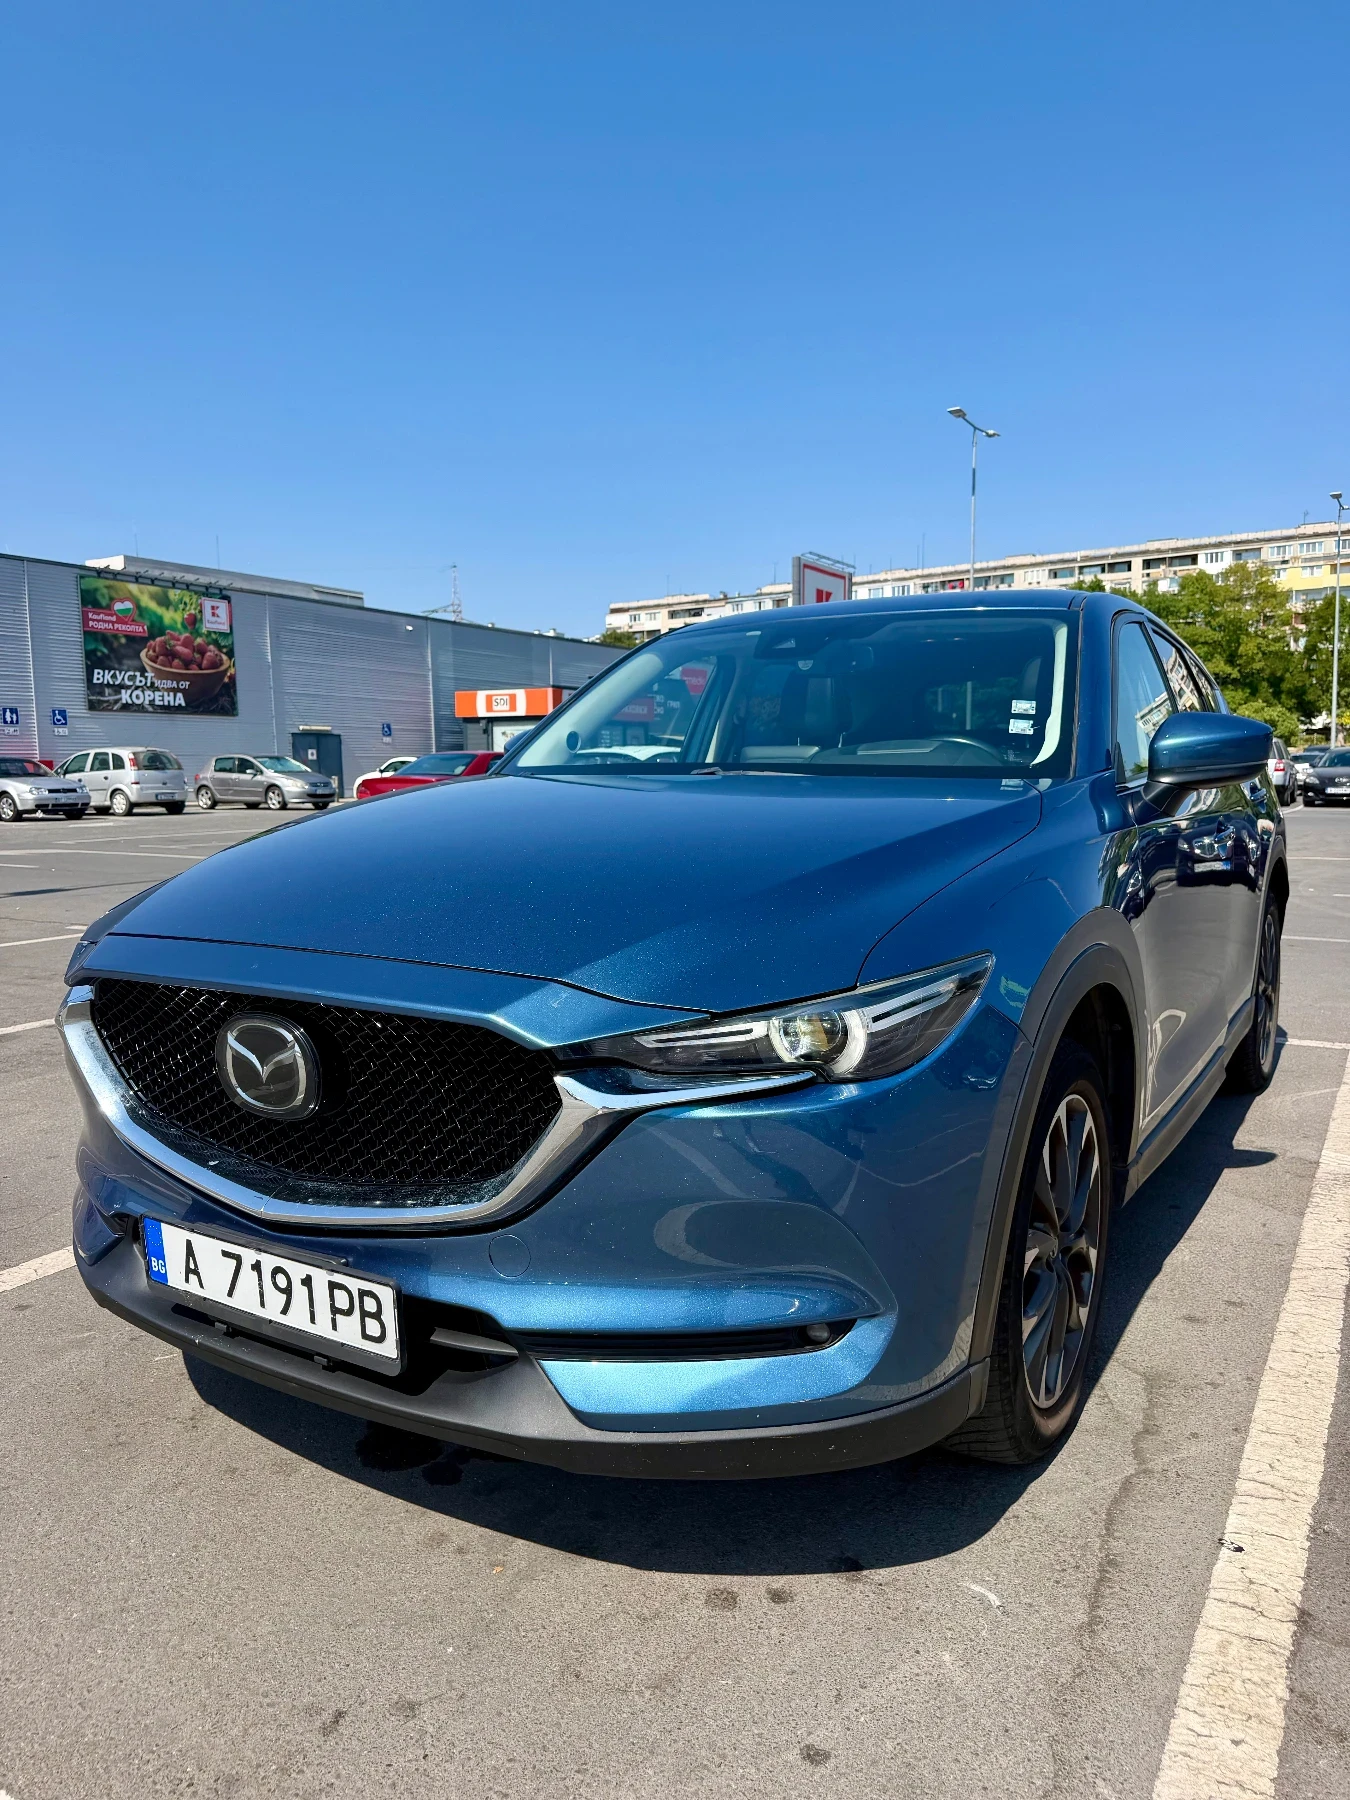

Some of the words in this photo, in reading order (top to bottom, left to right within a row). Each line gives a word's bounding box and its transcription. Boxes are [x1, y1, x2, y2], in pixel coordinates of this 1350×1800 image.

[88, 612, 117, 621] Kaufland
[88, 620, 113, 630] РОДНА
[114, 623, 143, 632] РЕКОЛТА
[92, 668, 155, 687] ВКУСЪТ
[155, 680, 177, 689] ИДВА
[178, 681, 191, 690] ОТ
[120, 688, 186, 707] КОРЕНА
[493, 697, 508, 707] SDI
[151, 1256, 166, 1274] BG
